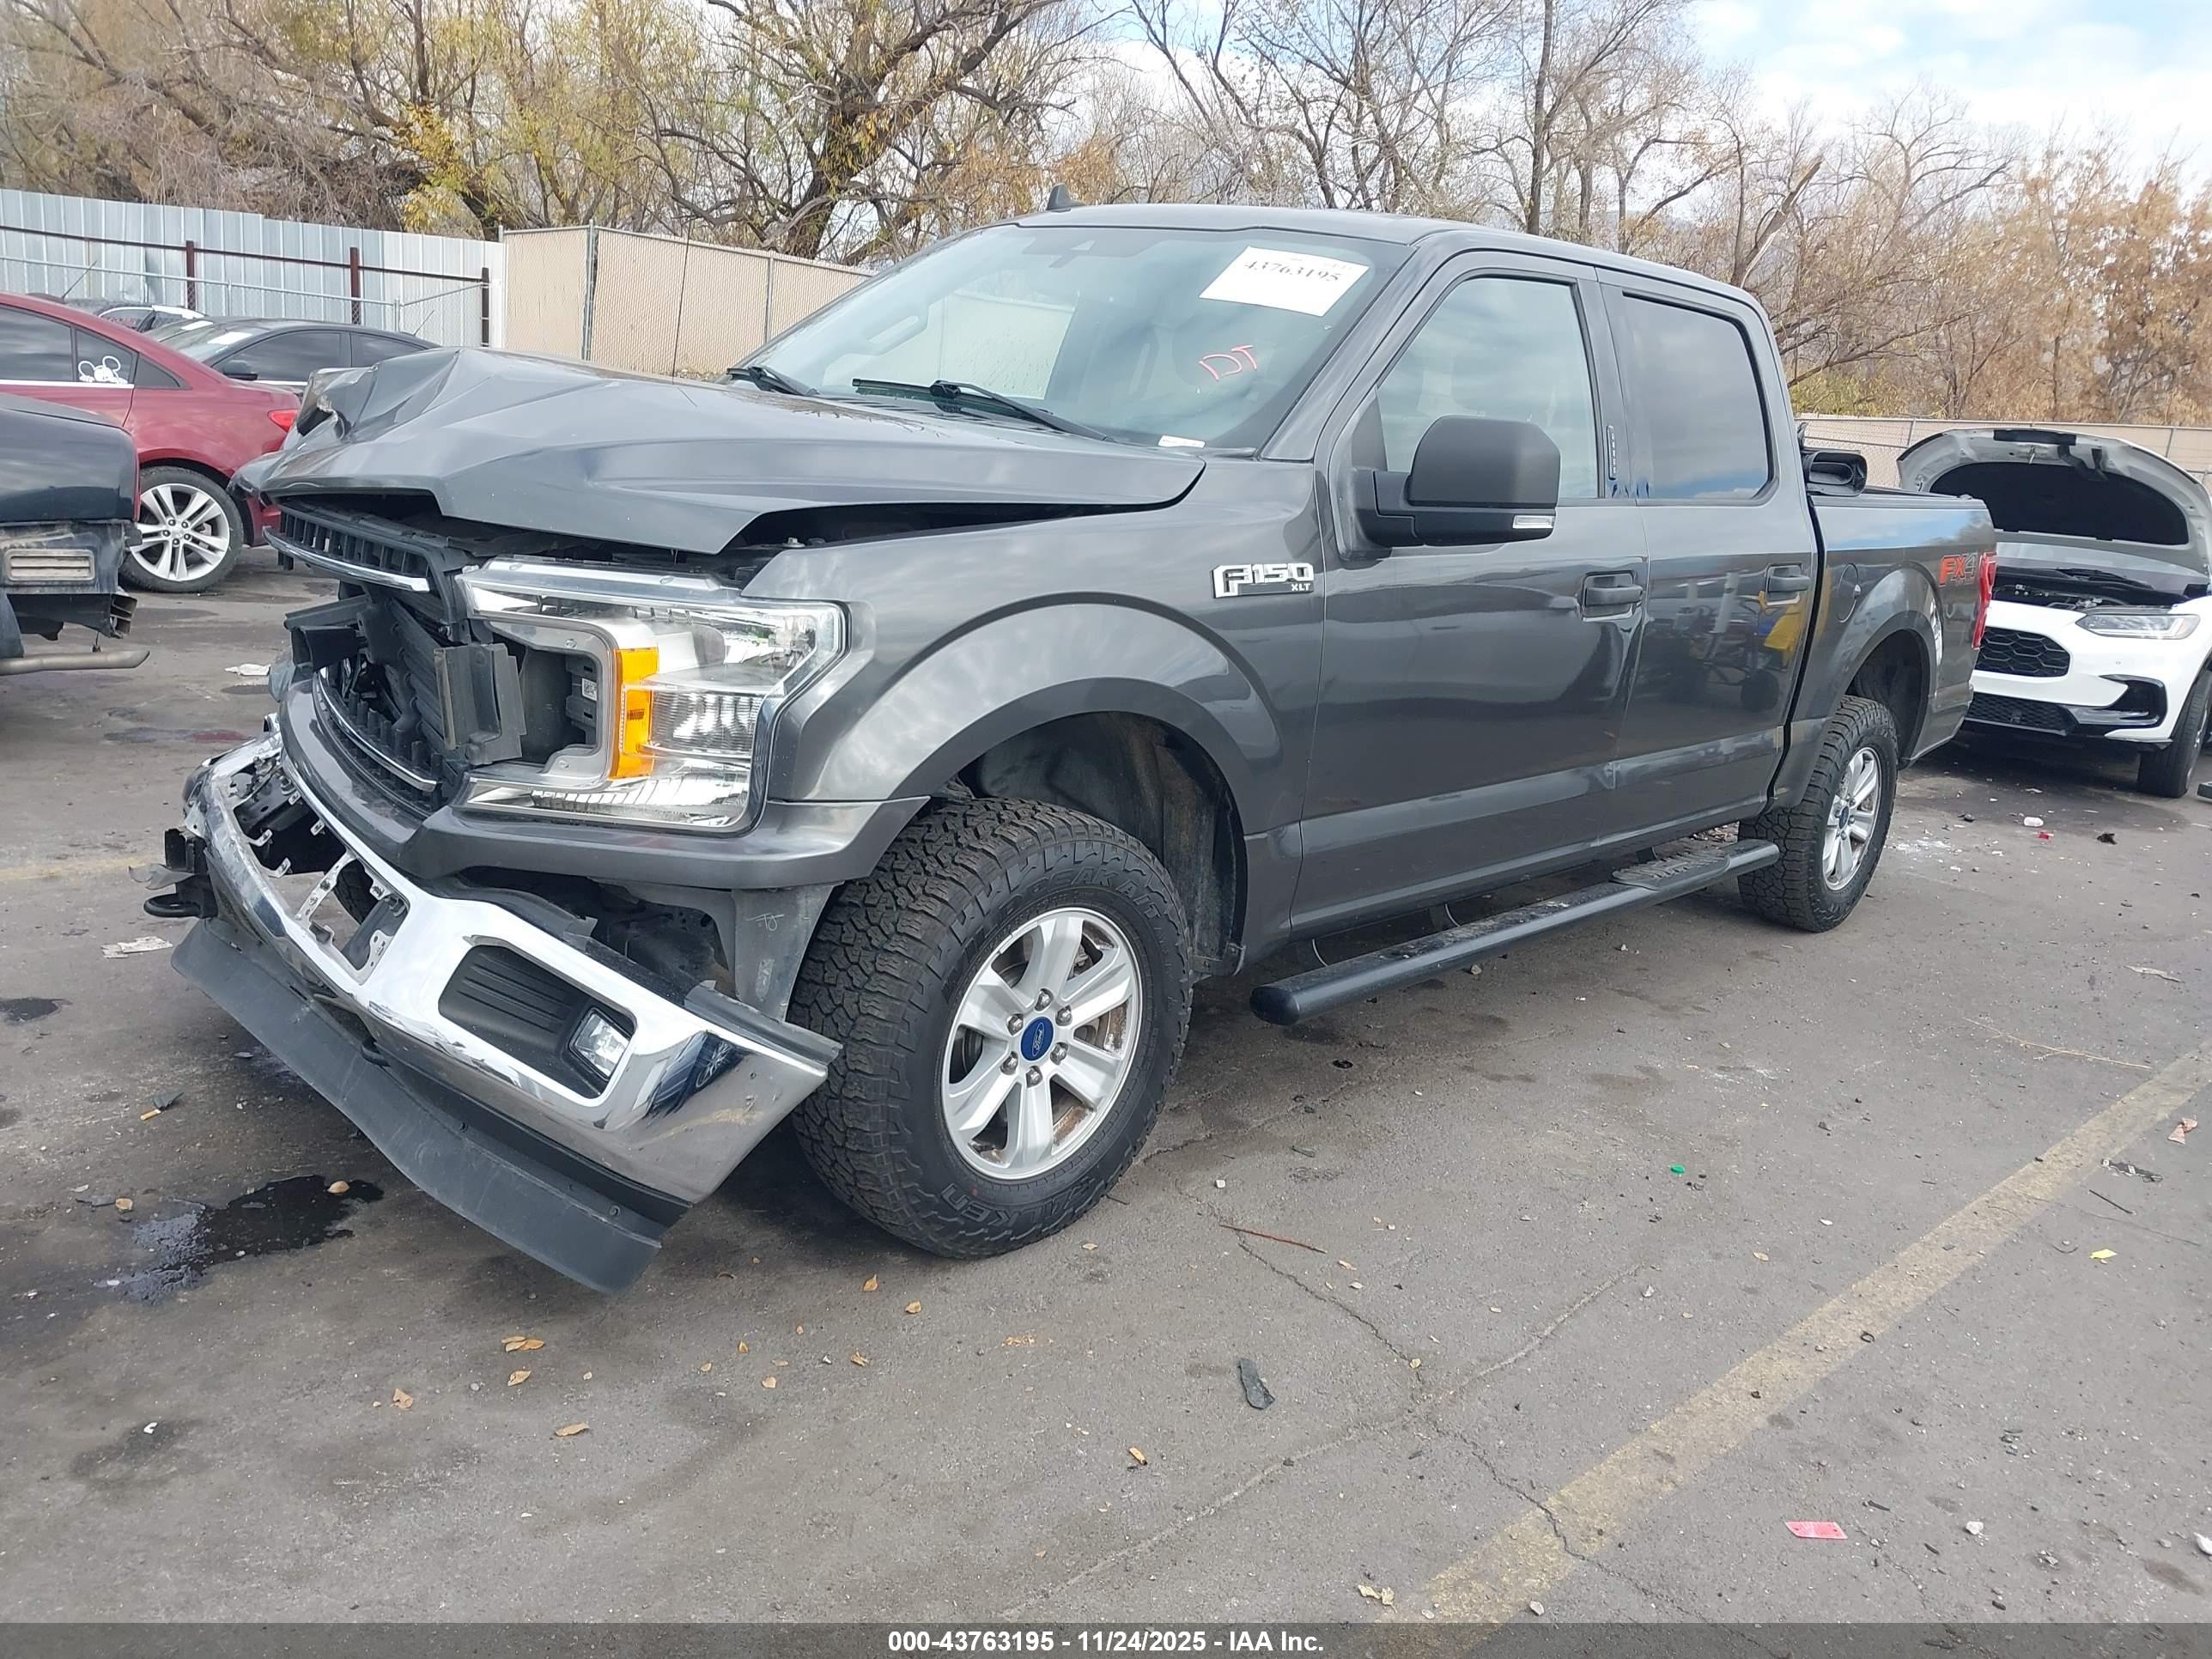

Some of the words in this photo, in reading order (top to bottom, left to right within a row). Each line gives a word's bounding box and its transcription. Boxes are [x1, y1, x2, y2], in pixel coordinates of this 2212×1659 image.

[1244, 260, 1341, 282] 43763195
[1938, 552, 1978, 587] FX4
[1291, 583, 1311, 592] XLT
